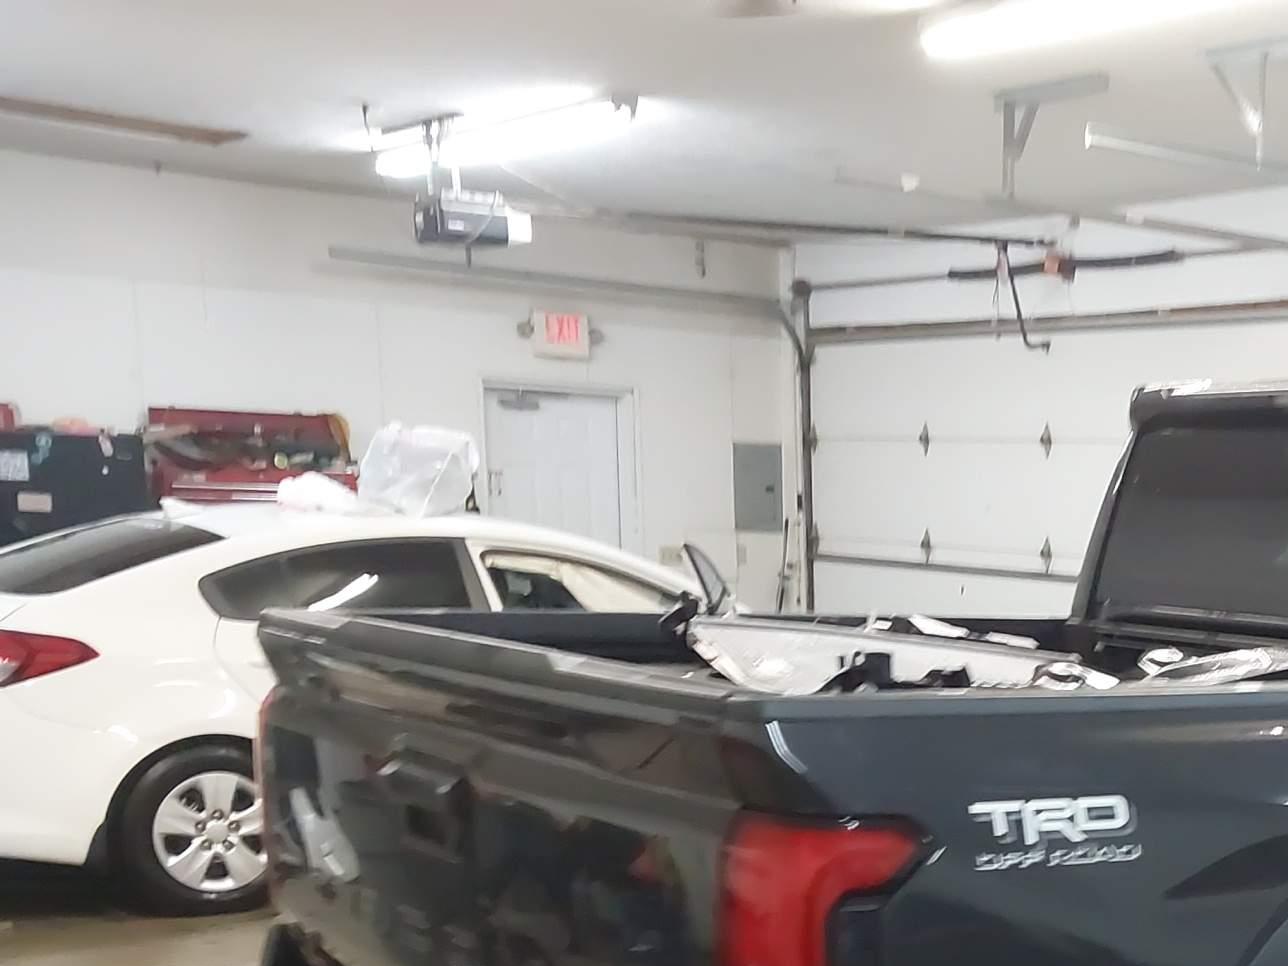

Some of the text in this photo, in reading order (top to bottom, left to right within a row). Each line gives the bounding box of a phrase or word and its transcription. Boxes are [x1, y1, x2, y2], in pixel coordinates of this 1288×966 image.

[545, 313, 580, 344] EXIT
[967, 794, 1132, 846] TRD
[974, 844, 1143, 871] OFF ROAD
